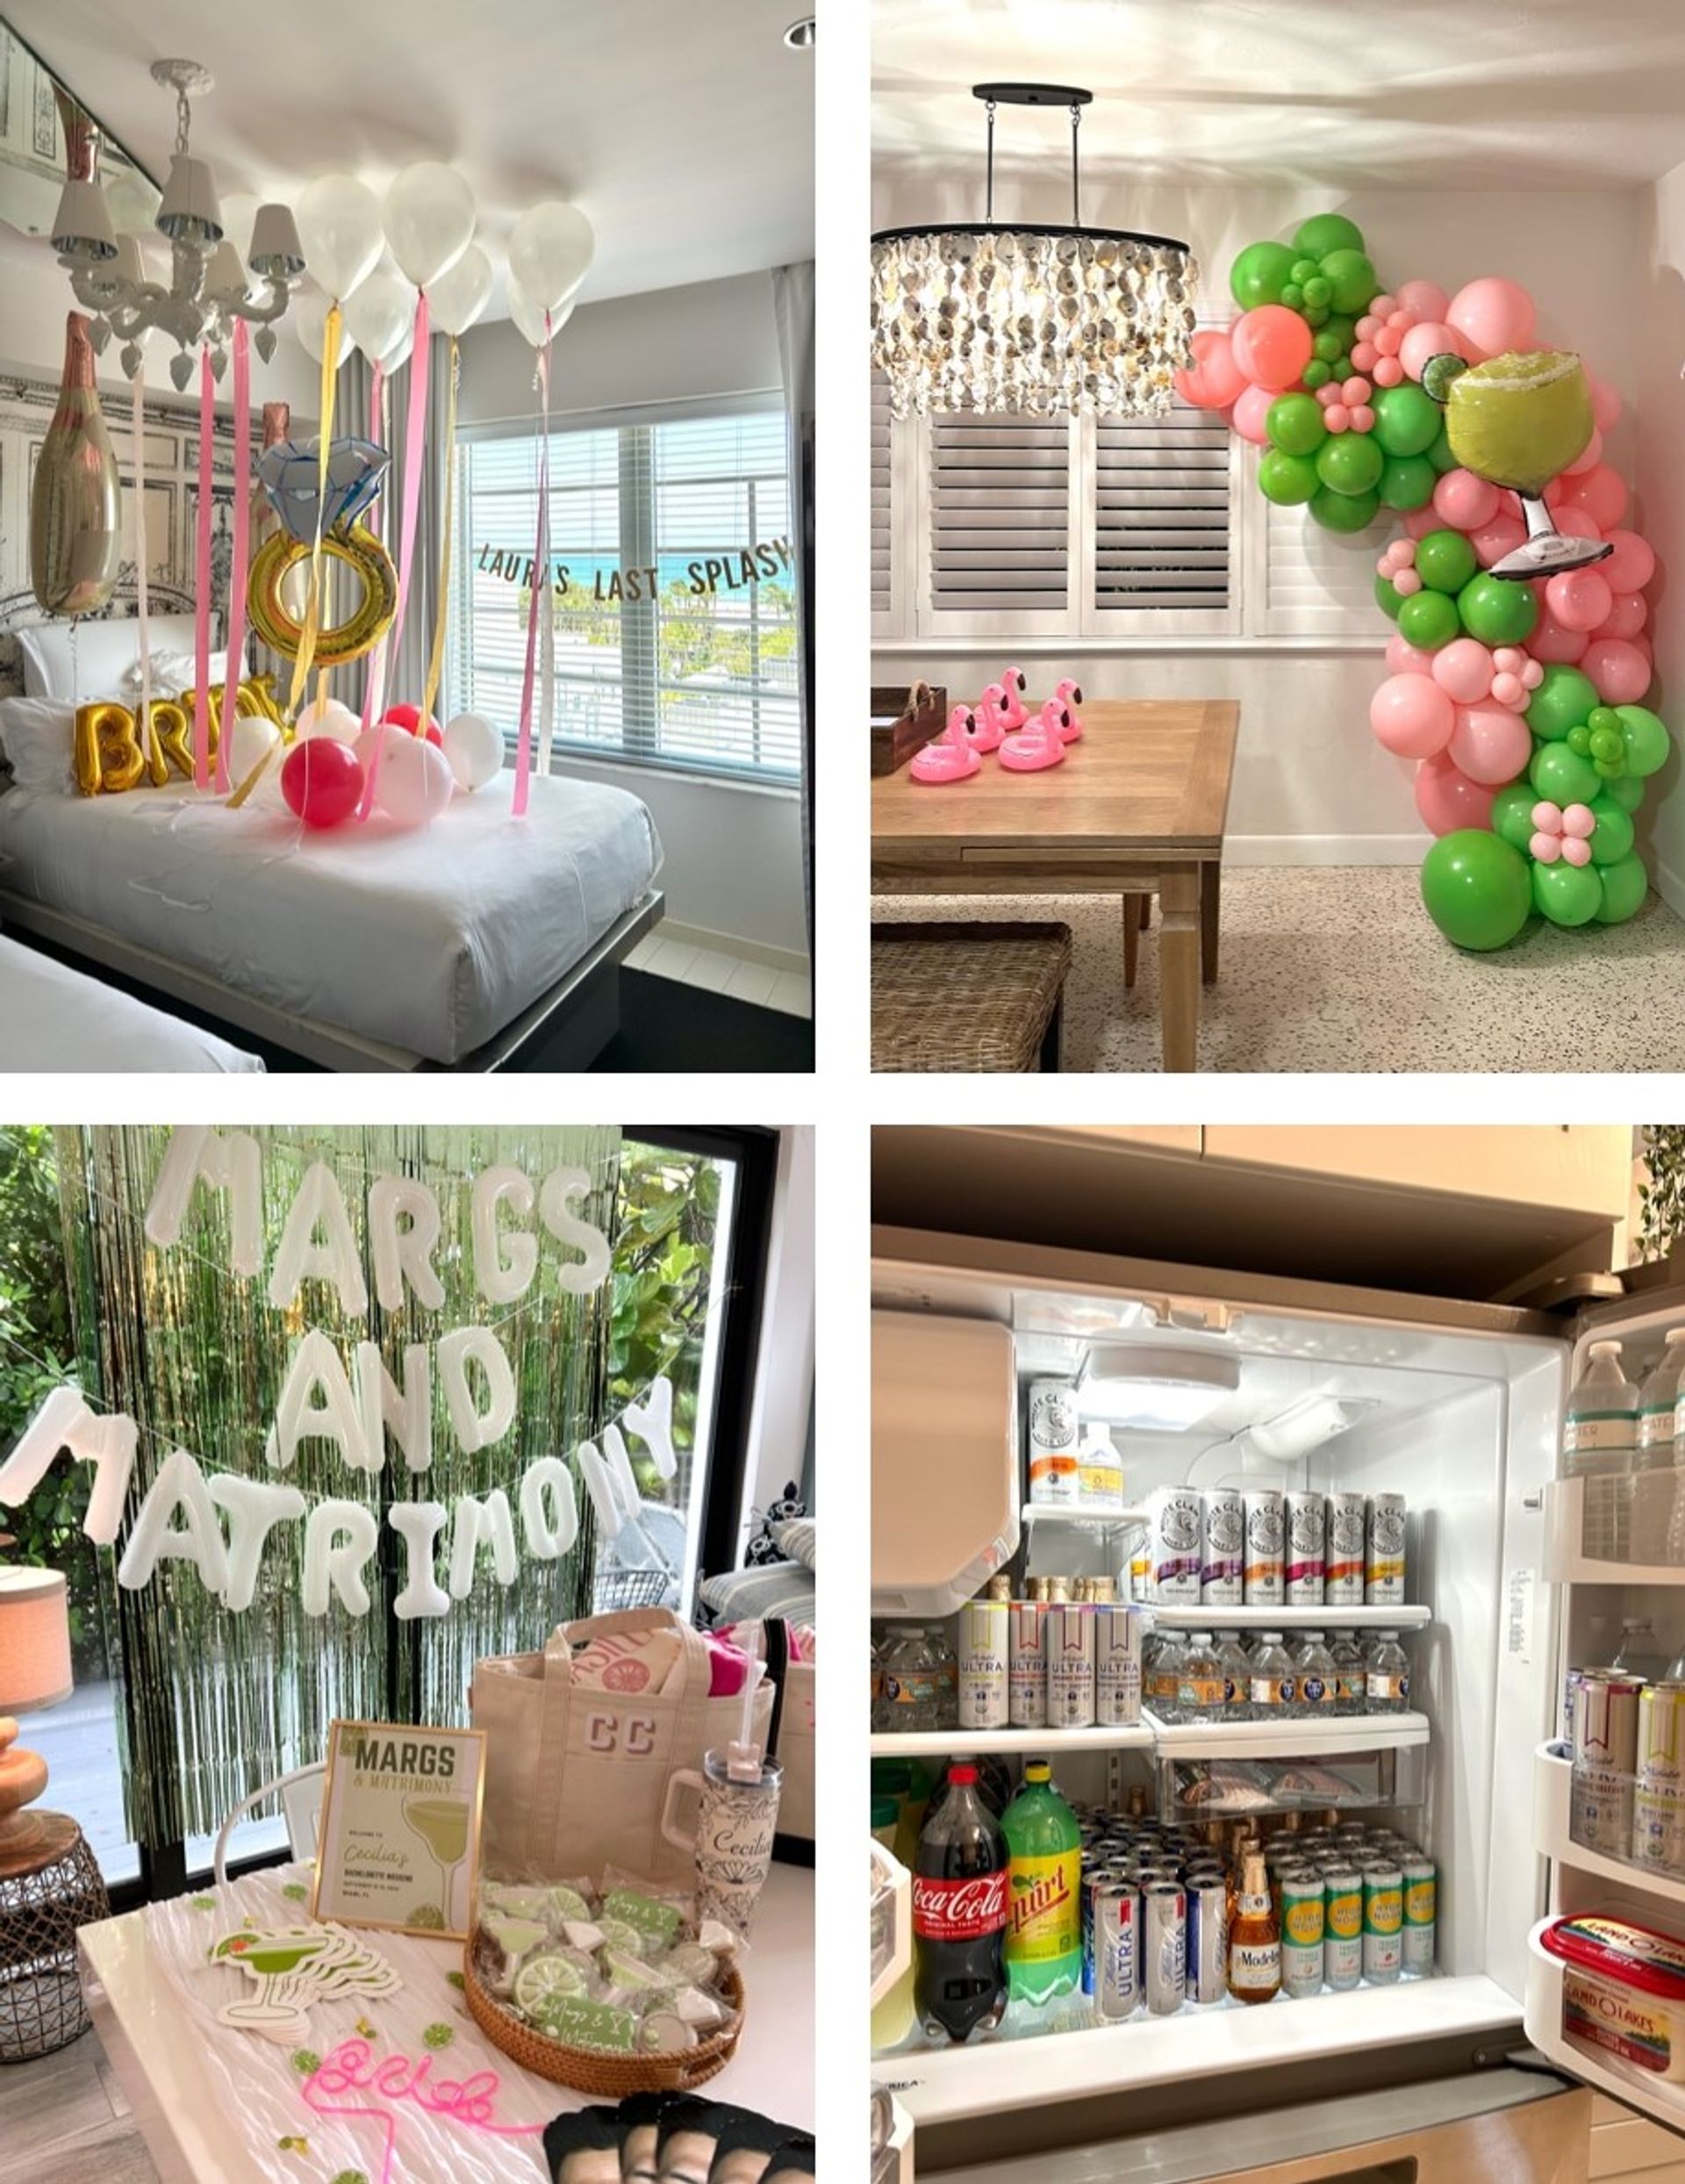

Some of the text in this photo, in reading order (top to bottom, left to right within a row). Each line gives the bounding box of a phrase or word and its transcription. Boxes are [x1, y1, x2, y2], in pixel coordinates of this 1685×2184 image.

[594, 567, 659, 601] LAST
[144, 1125, 613, 1316] MARGS
[266, 1326, 518, 1473] AND
[0, 1376, 677, 1619] MATRIMONY
[961, 1661, 1003, 1672] ULTRA
[1052, 1662, 1092, 1673] ULTRA
[1100, 1663, 1138, 1673] ULTRA
[355, 1738, 456, 1778] MARGS
[369, 1774, 452, 1794] MATRIMONY
[1010, 1863, 1065, 1934] quirt
[1118, 1928, 1133, 1998] ULTRA
